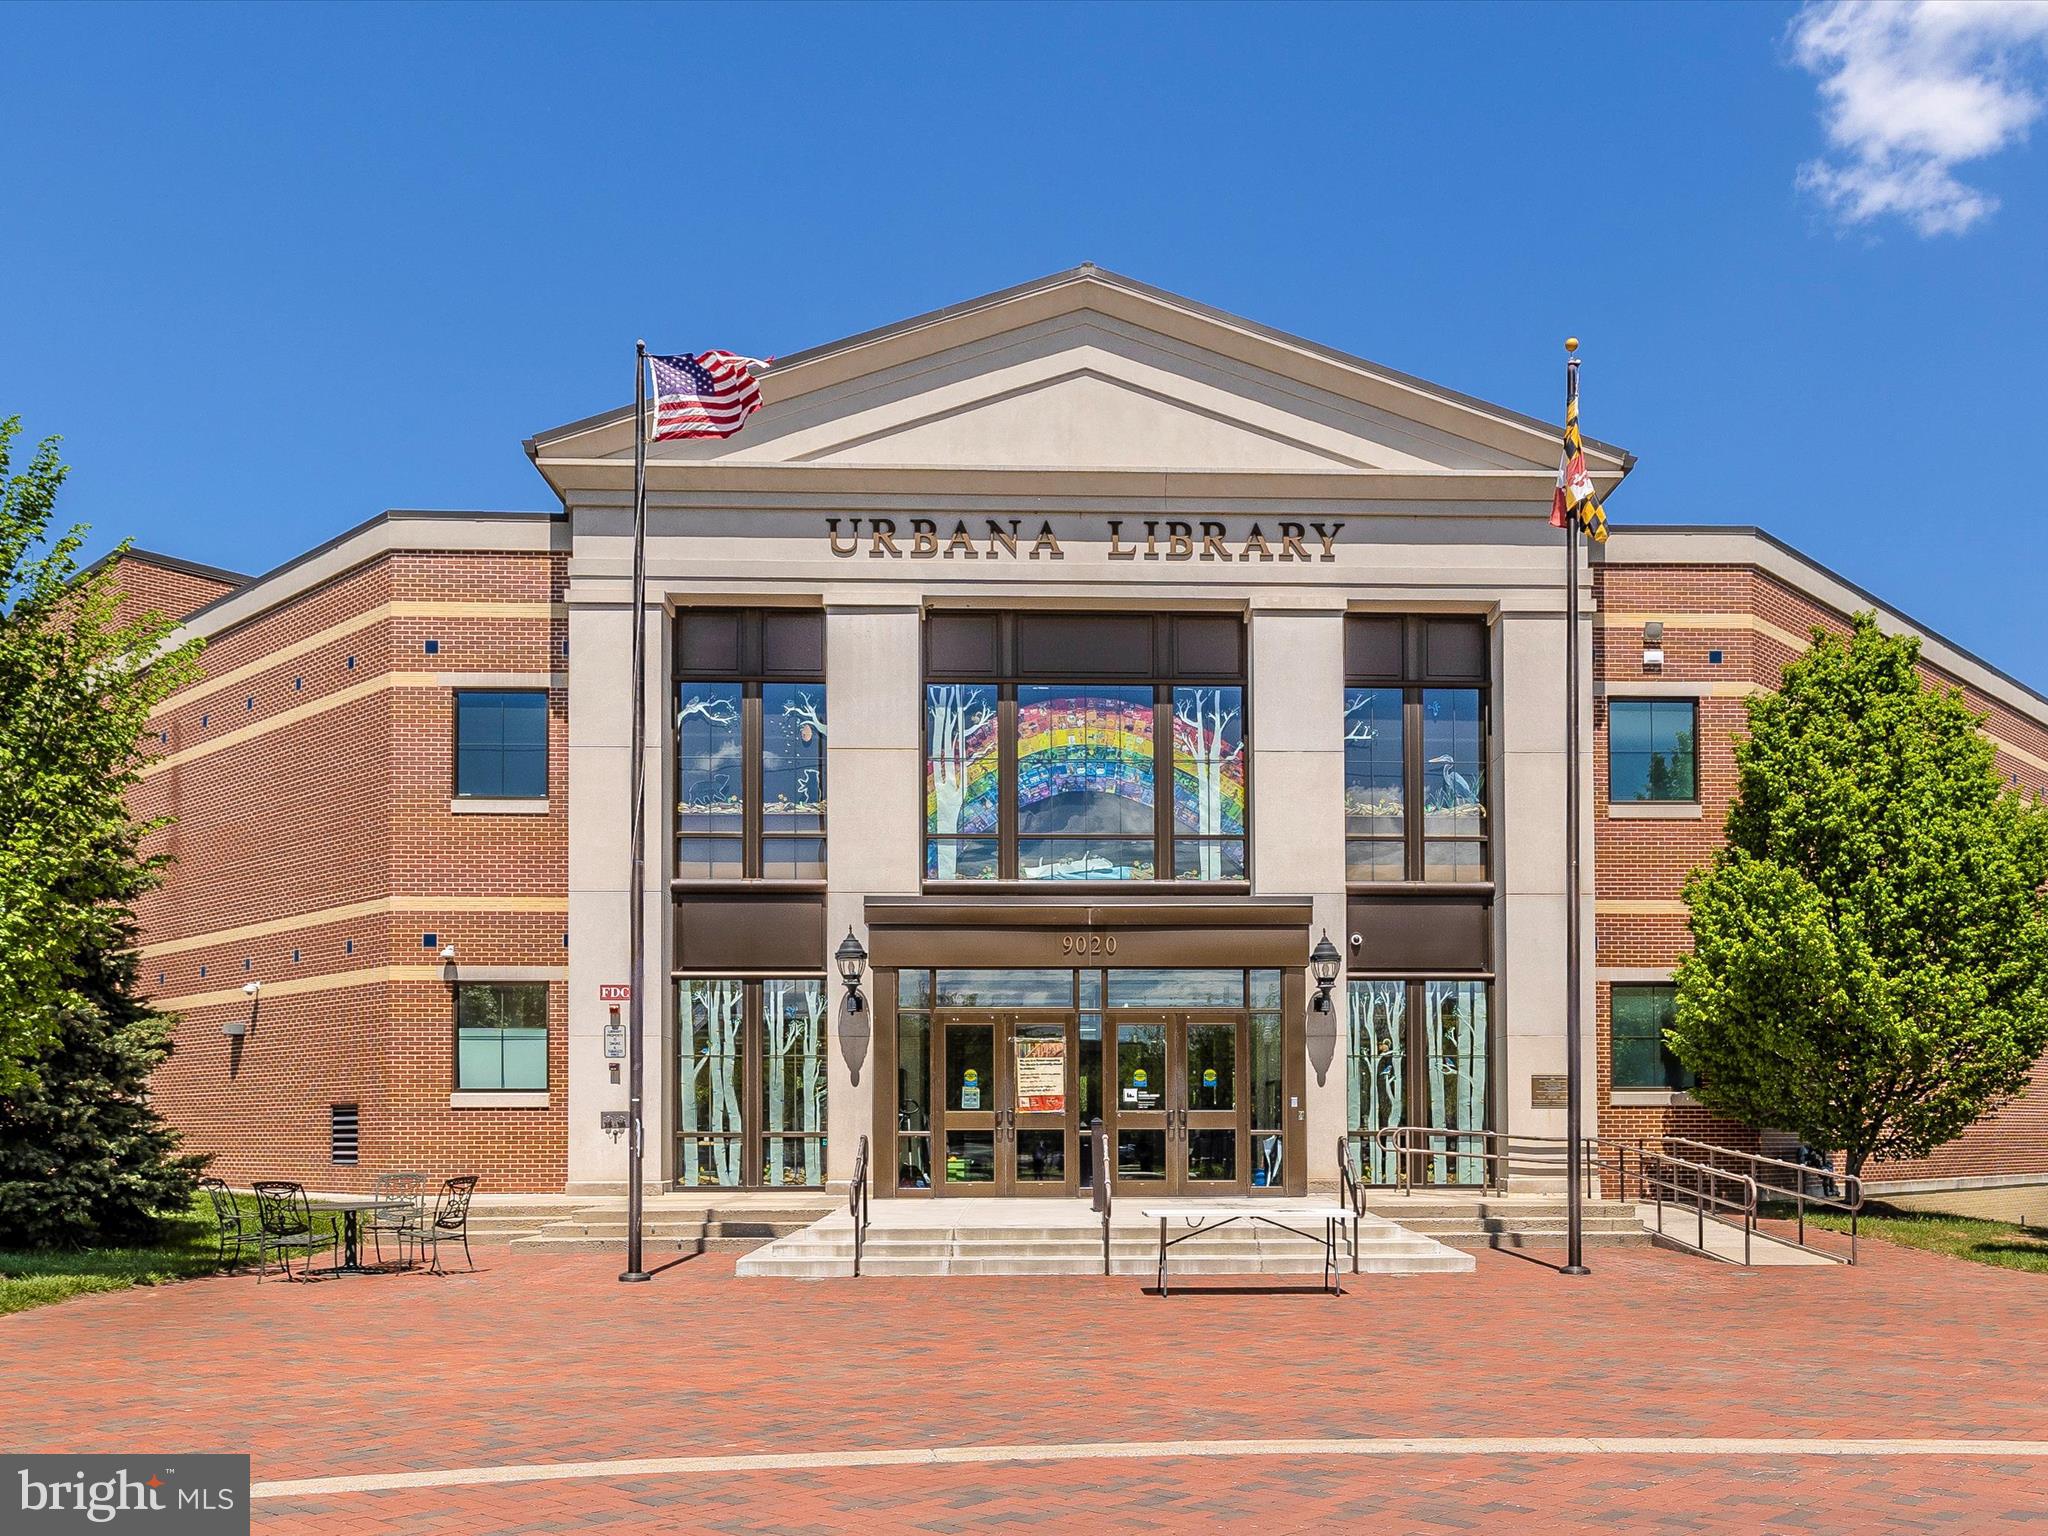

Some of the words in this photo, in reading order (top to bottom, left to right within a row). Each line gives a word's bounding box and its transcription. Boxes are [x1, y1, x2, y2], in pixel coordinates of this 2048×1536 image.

[825, 518, 1065, 559] URBANA
[1106, 519, 1346, 562] LIBRARY
[1063, 936, 1116, 953] 9020
[601, 987, 629, 998] FDC
